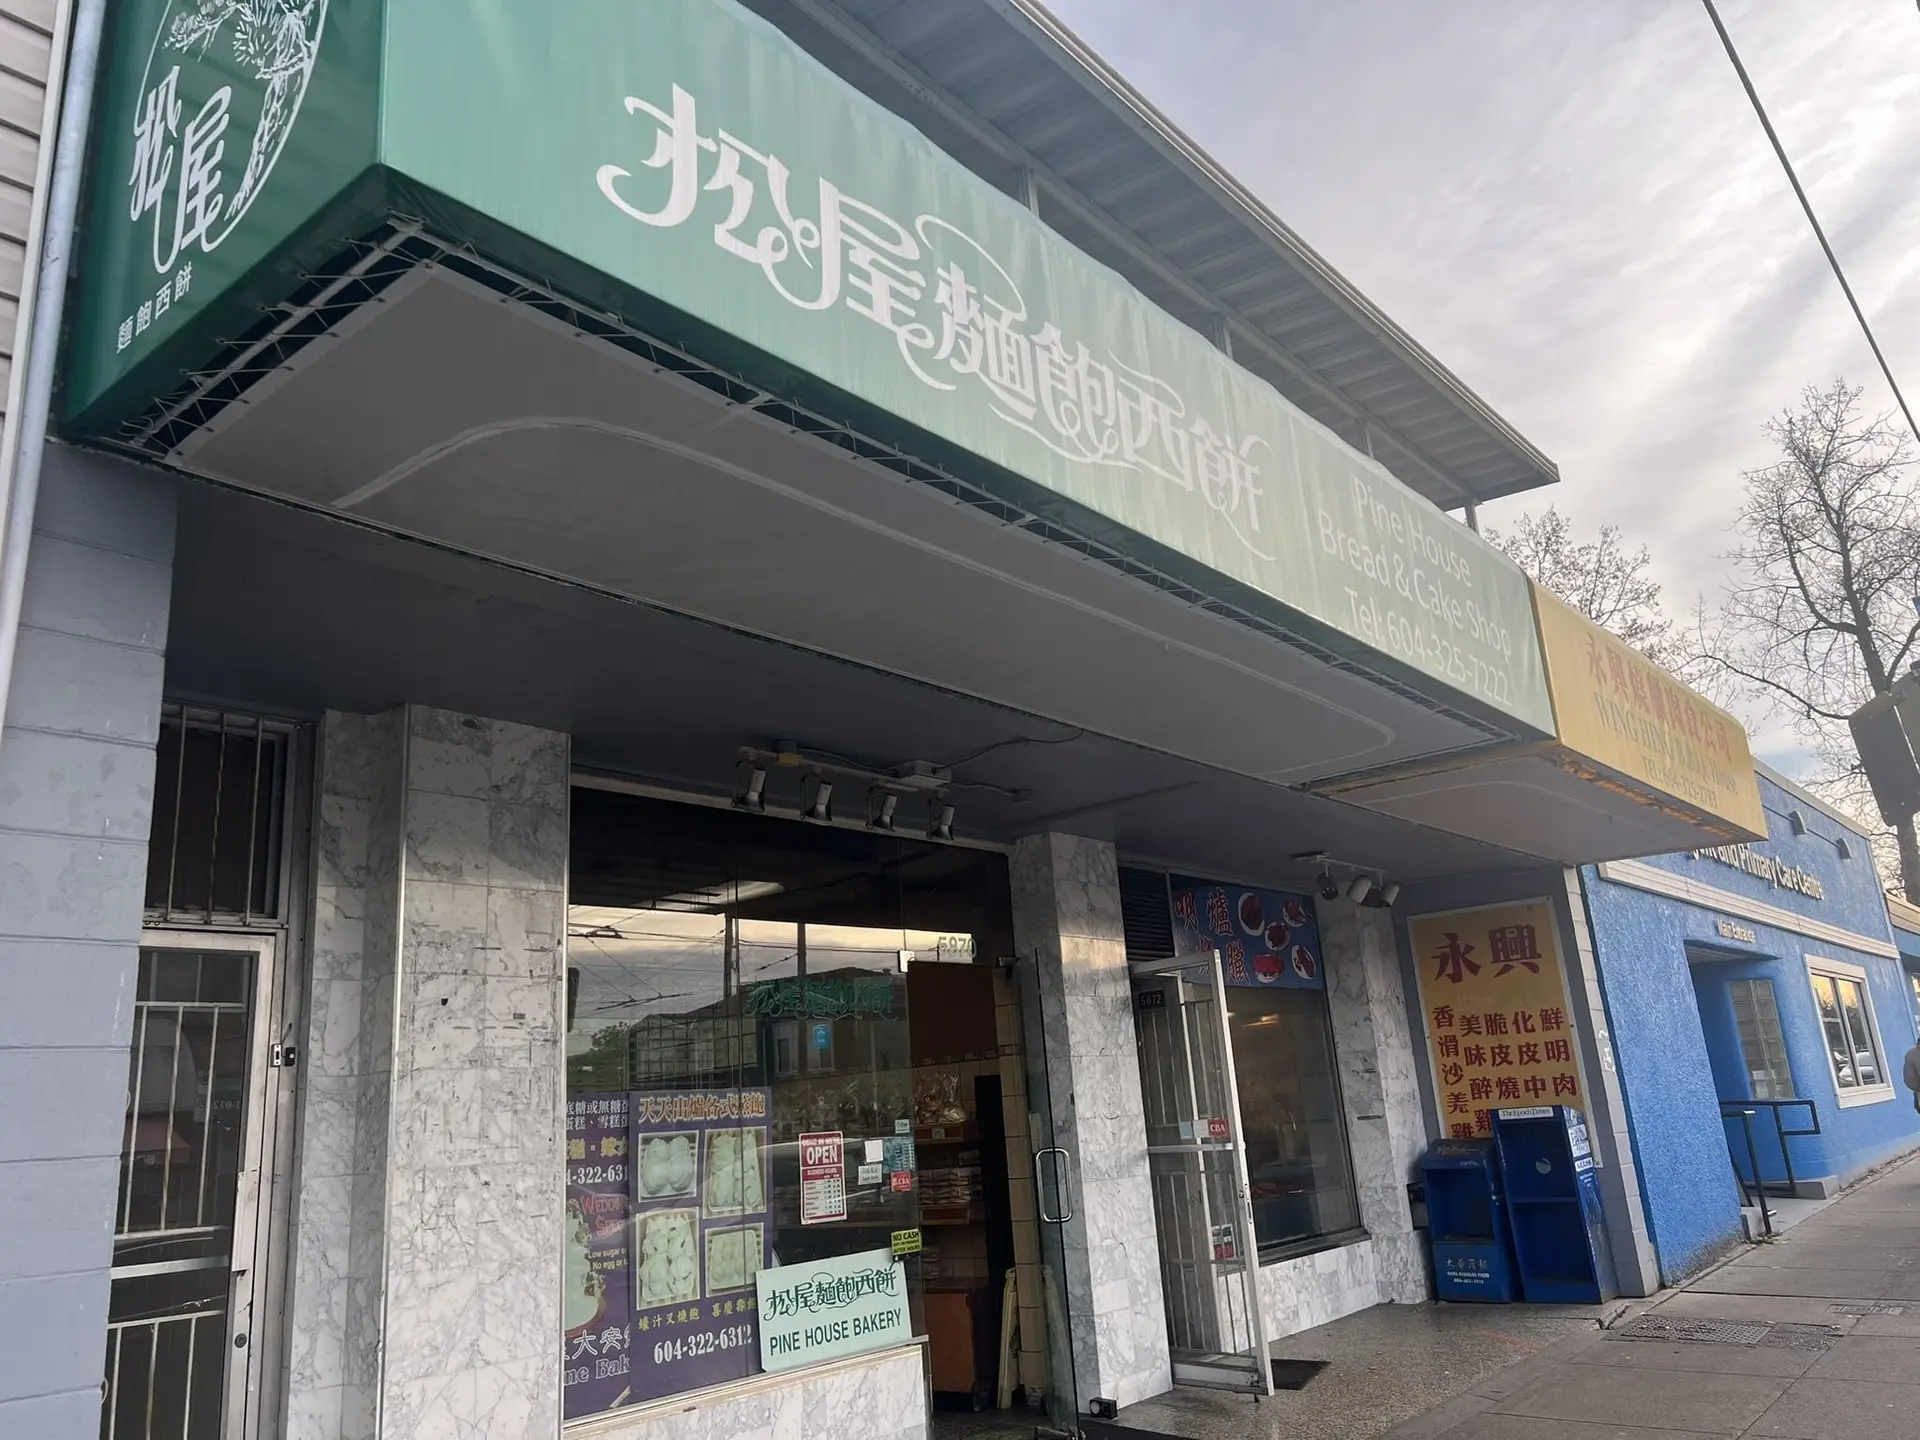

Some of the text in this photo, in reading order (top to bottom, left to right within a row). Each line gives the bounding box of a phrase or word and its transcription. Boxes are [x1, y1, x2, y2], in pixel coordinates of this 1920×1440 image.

[1353, 477, 1473, 588] Pine House
[1318, 509, 1513, 663] Bread & Cake Shop
[1344, 585, 1513, 707] Tel: 604-325-7222
[1594, 691, 1640, 744] WING
[1738, 843, 1778, 889] Primary
[939, 936, 977, 958] 5870
[1431, 924, 1543, 984] 永興
[806, 1145, 838, 1165] OPEN
[587, 1250, 602, 1259] Low
[603, 1247, 620, 1258] sugar
[893, 1231, 919, 1242] NO CASH
[592, 1261, 602, 1269] No
[654, 1324, 752, 1364] 604-322-6312
[770, 1308, 901, 1356] PINE HOUSE BAKERY
